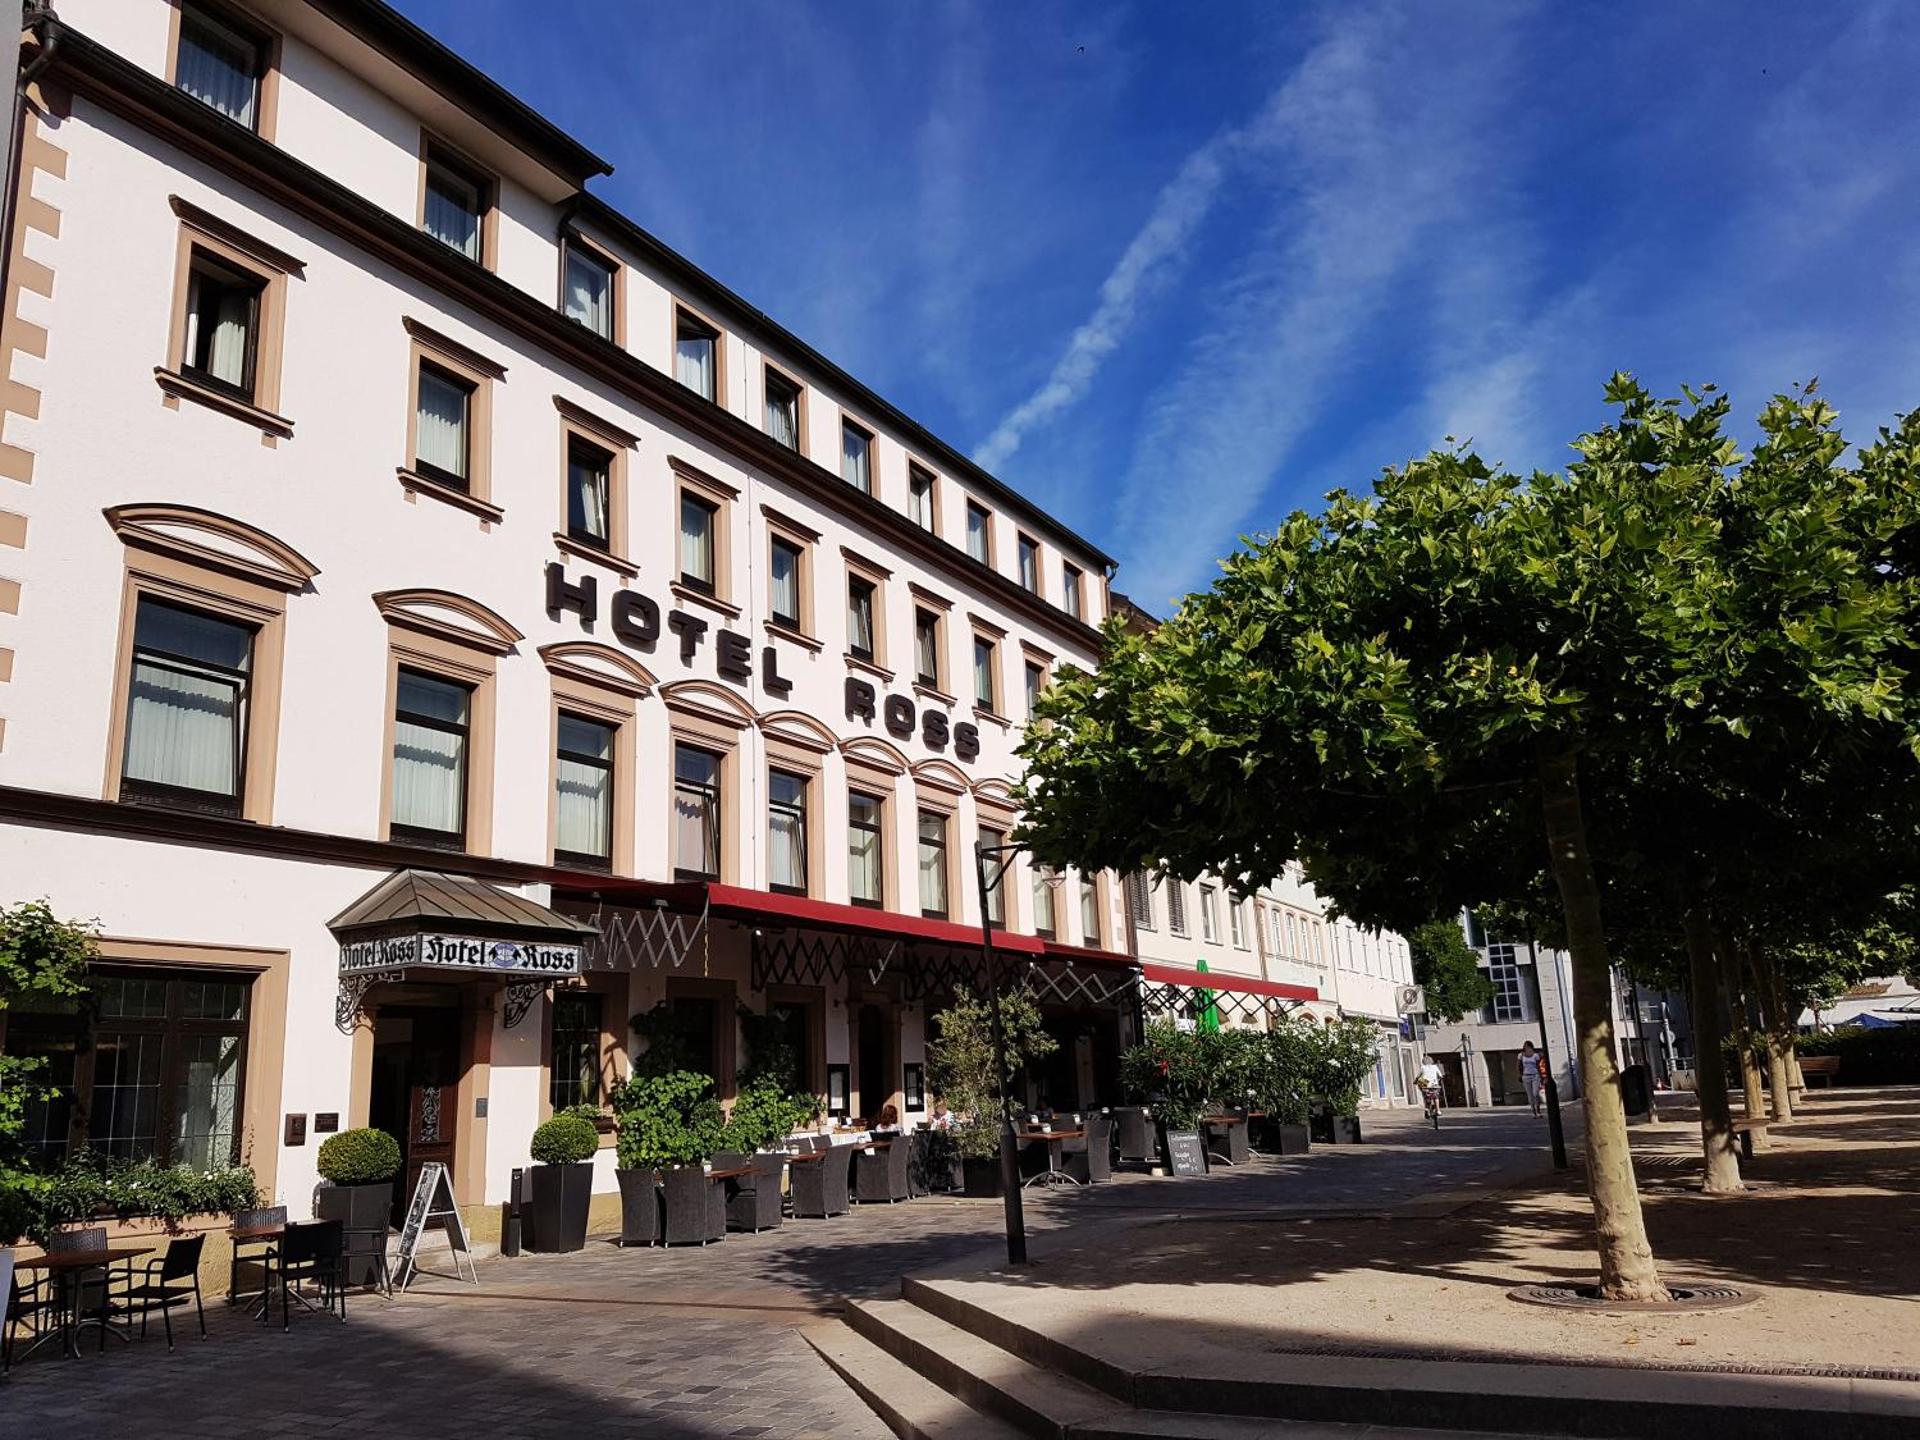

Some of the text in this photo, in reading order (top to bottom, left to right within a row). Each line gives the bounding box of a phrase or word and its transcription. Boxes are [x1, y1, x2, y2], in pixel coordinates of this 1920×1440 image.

[546, 562, 980, 761] HOTEL ROSS
[341, 939, 416, 970] Hotel Ross
[426, 936, 575, 971] Hotel Ross
